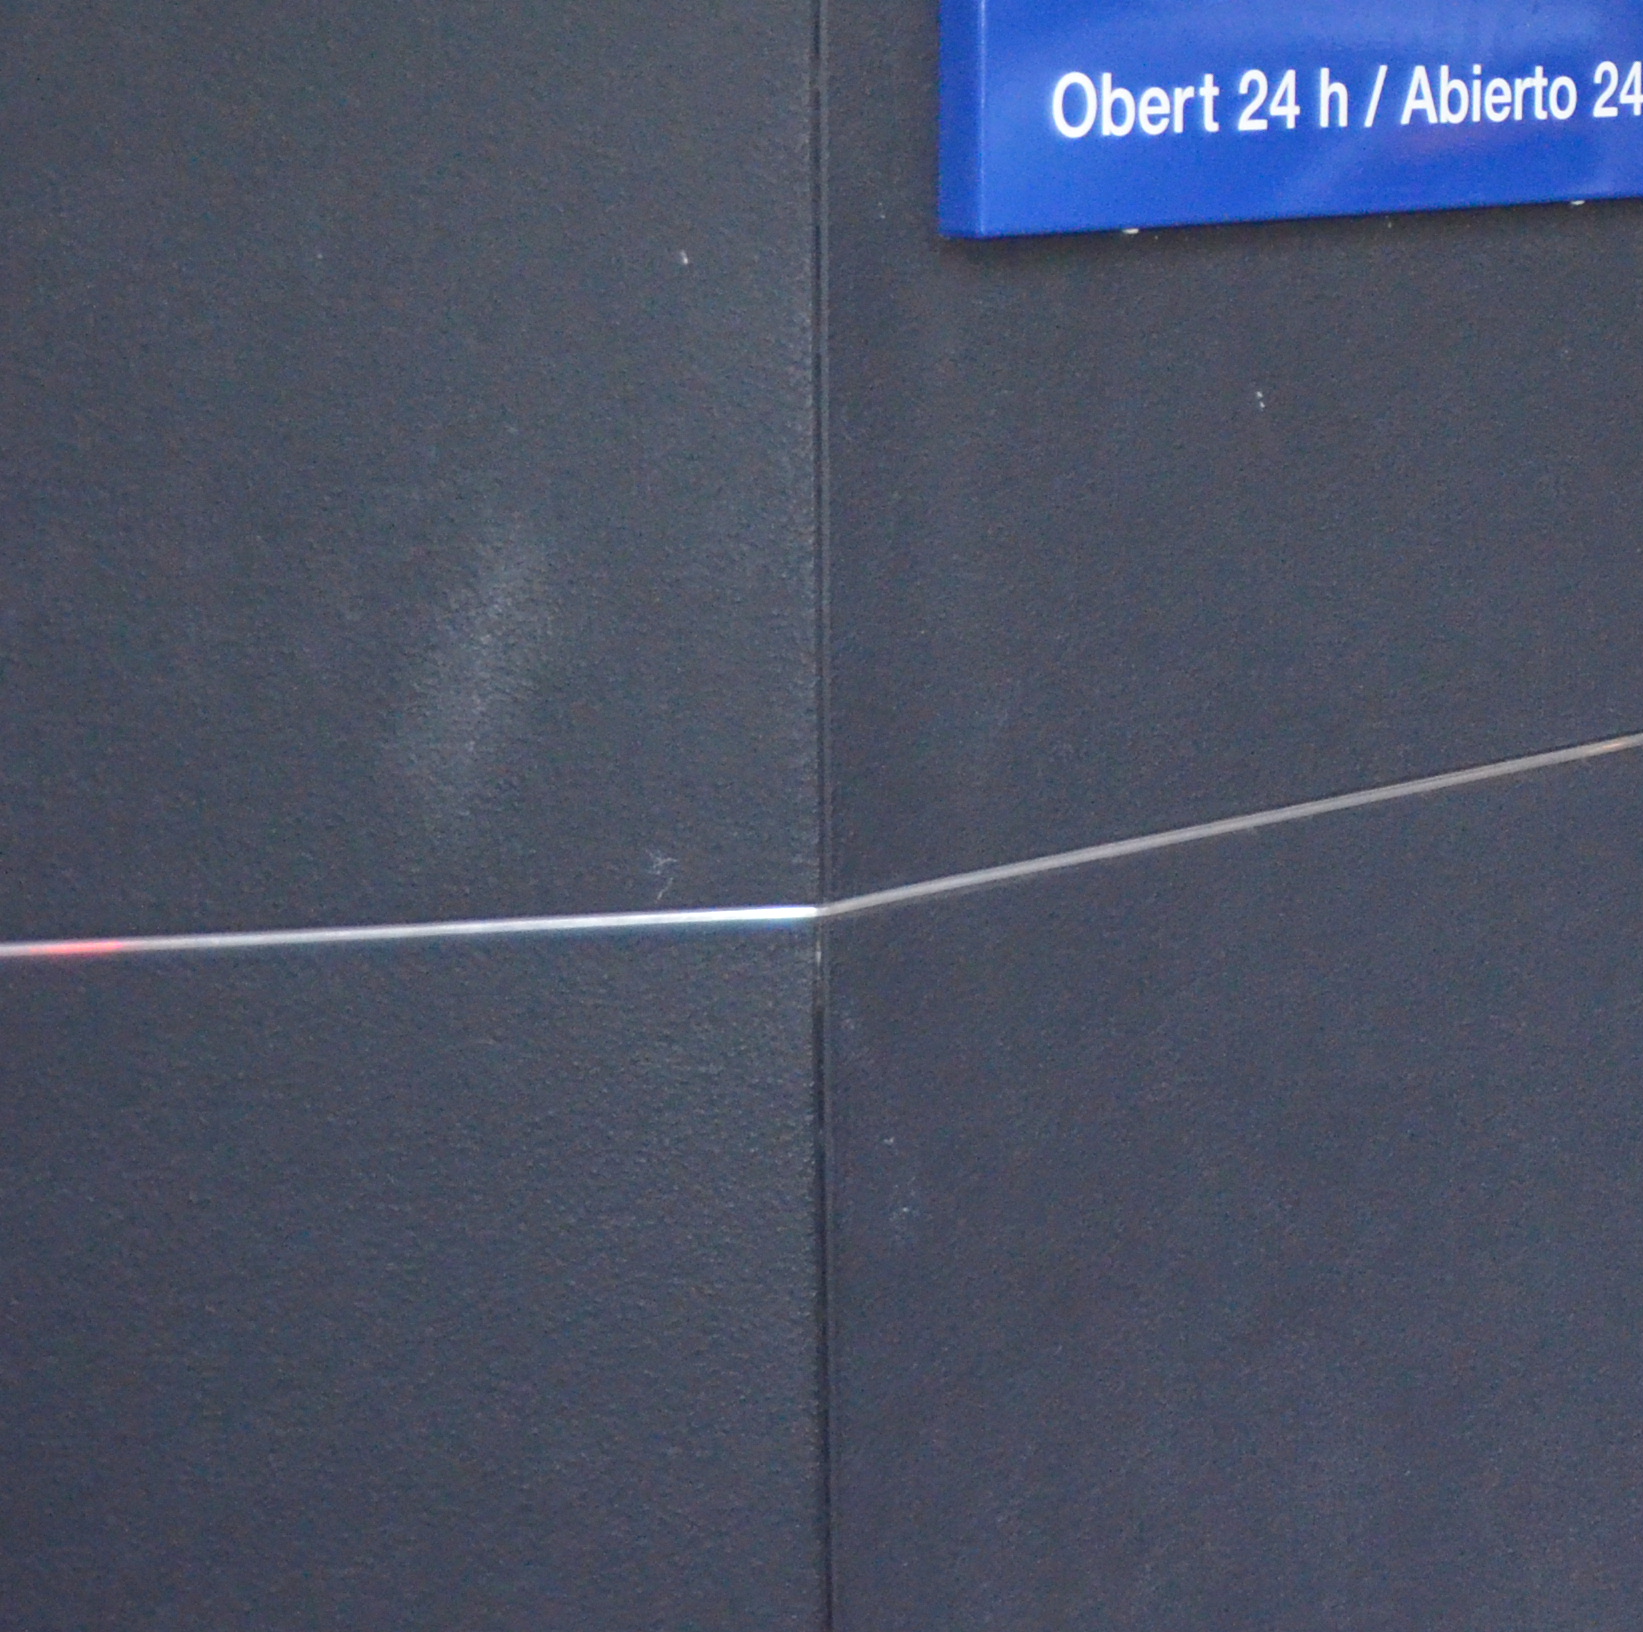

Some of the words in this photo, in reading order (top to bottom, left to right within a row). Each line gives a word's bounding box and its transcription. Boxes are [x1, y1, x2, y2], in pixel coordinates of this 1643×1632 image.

[1052, 70, 1220, 140] Obert
[1236, 68, 1301, 133] 24
[1317, 66, 1349, 129] h
[1363, 64, 1389, 130] /
[1399, 63, 1578, 126] Abierto
